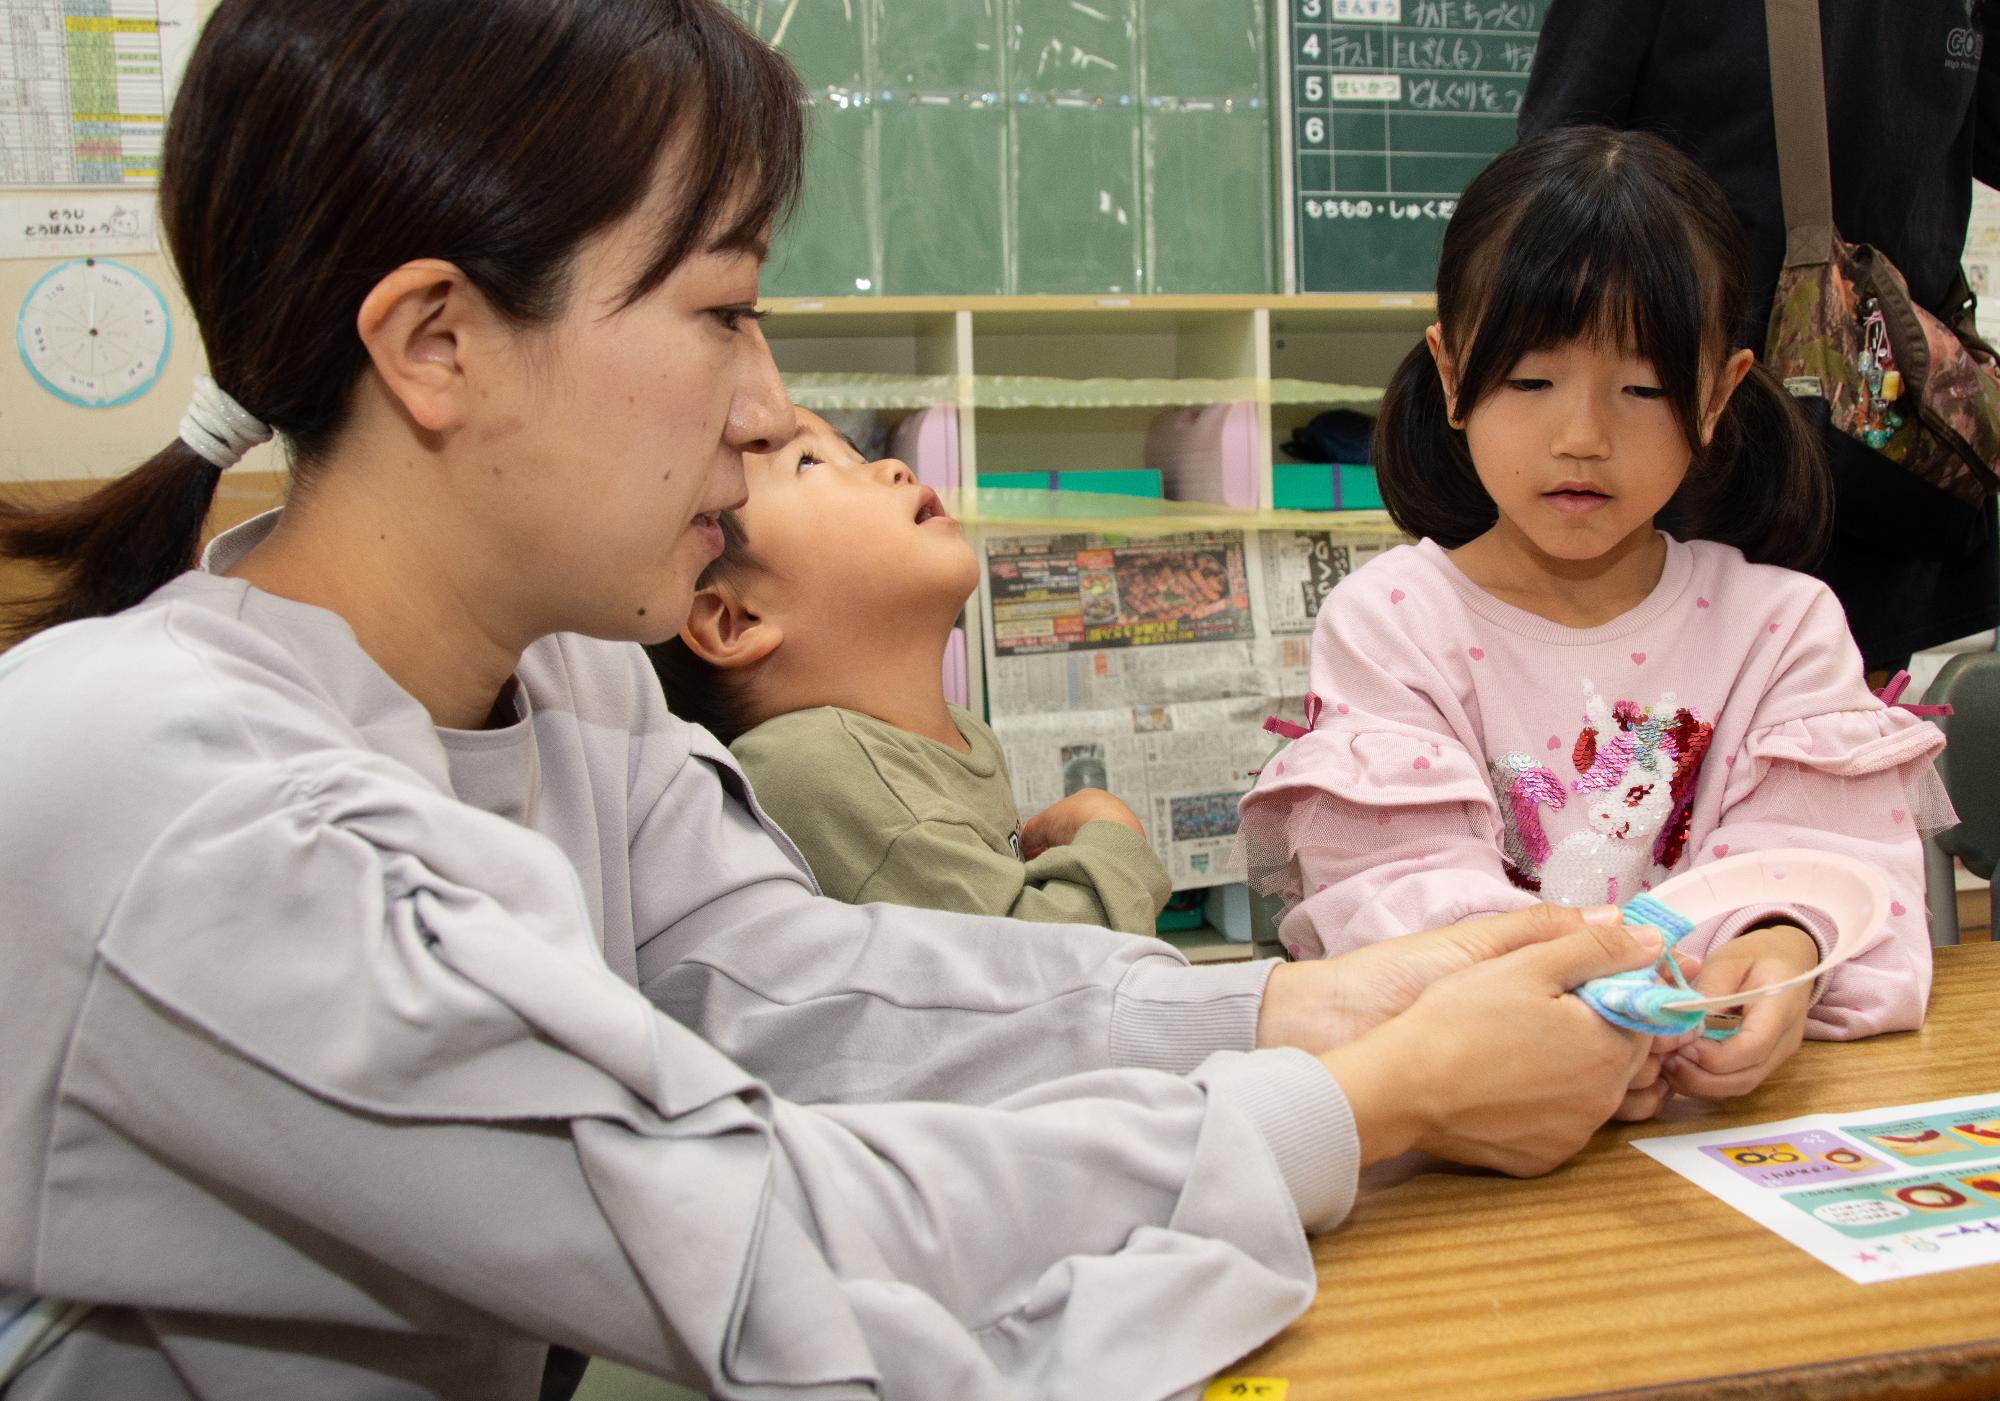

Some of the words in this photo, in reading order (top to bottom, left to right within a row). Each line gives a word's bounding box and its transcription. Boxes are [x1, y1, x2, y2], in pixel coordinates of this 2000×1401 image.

[1303, 33, 1321, 59] 4
[1304, 75, 1324, 102] 5
[1304, 116, 1325, 144] 6
